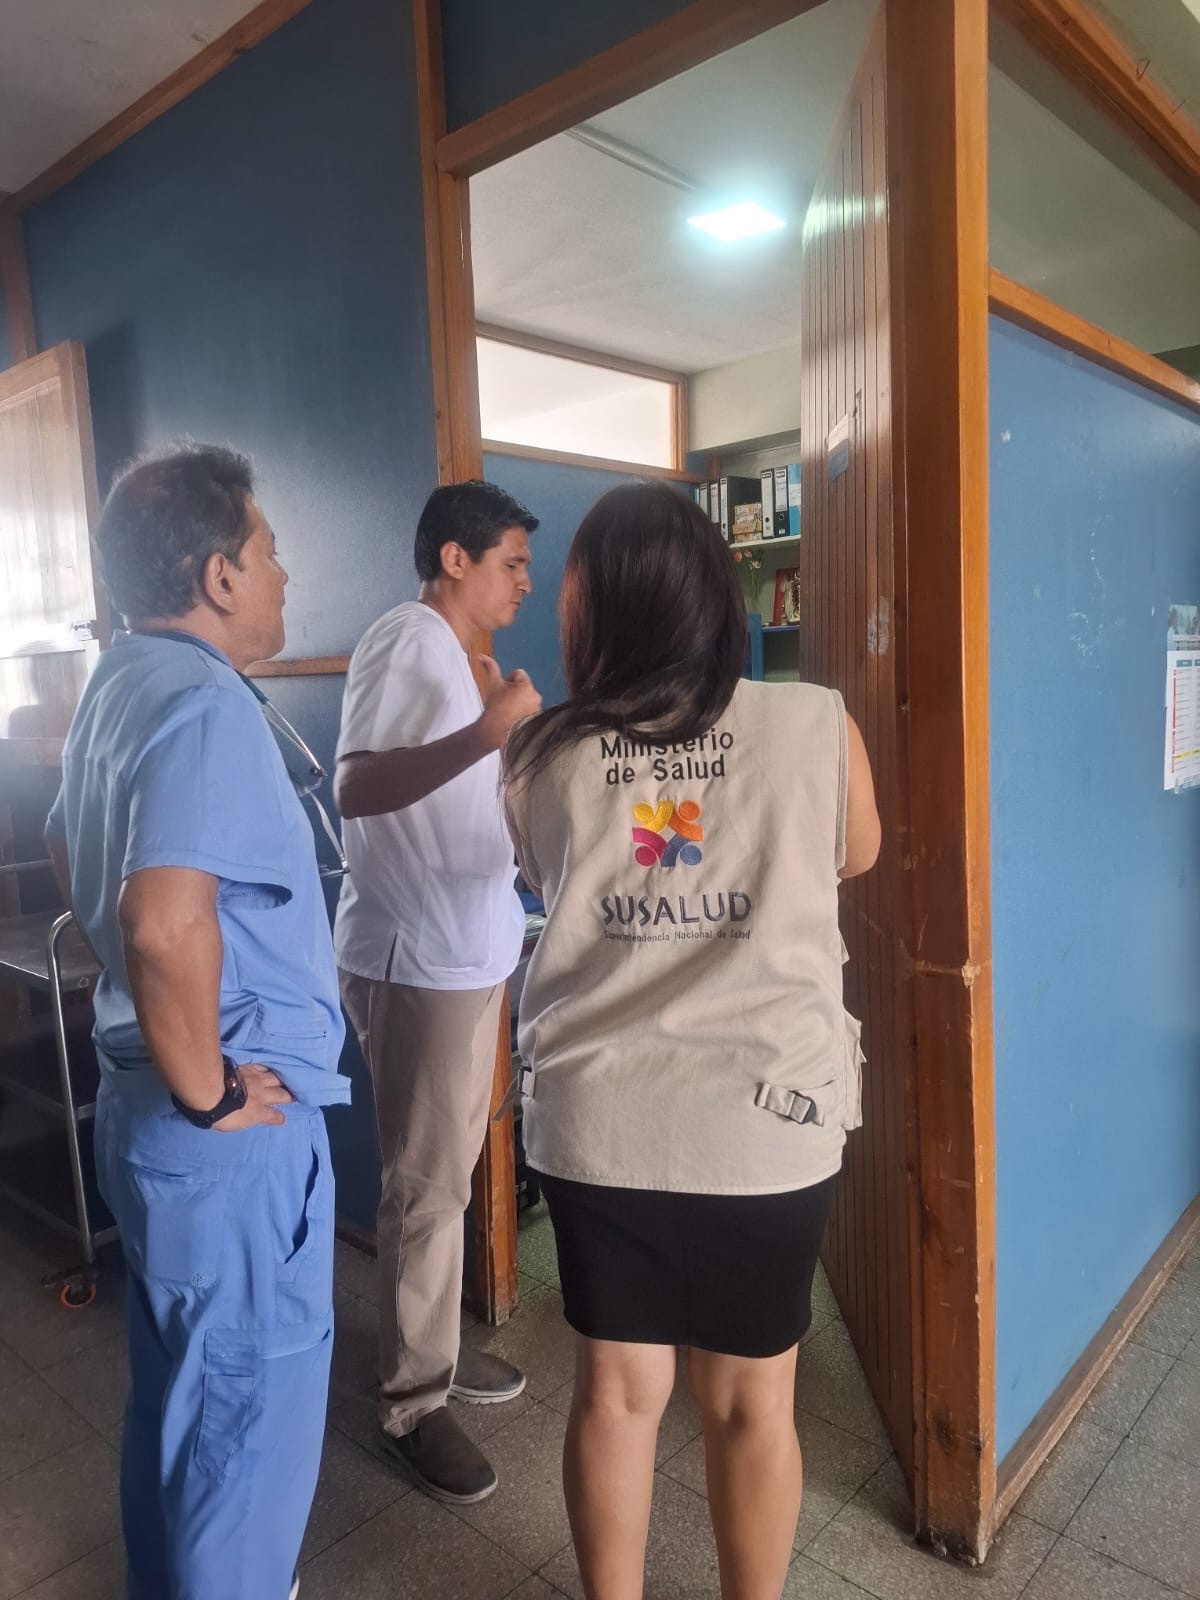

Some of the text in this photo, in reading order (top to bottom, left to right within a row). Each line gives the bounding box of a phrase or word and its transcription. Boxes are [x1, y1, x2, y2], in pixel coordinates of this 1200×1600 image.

[606, 754, 725, 785] de Salud
[601, 891, 752, 926] SUSALUD
[674, 930, 713, 940] Nacional
[717, 929, 727, 939] de
[730, 928, 751, 940] Salud
